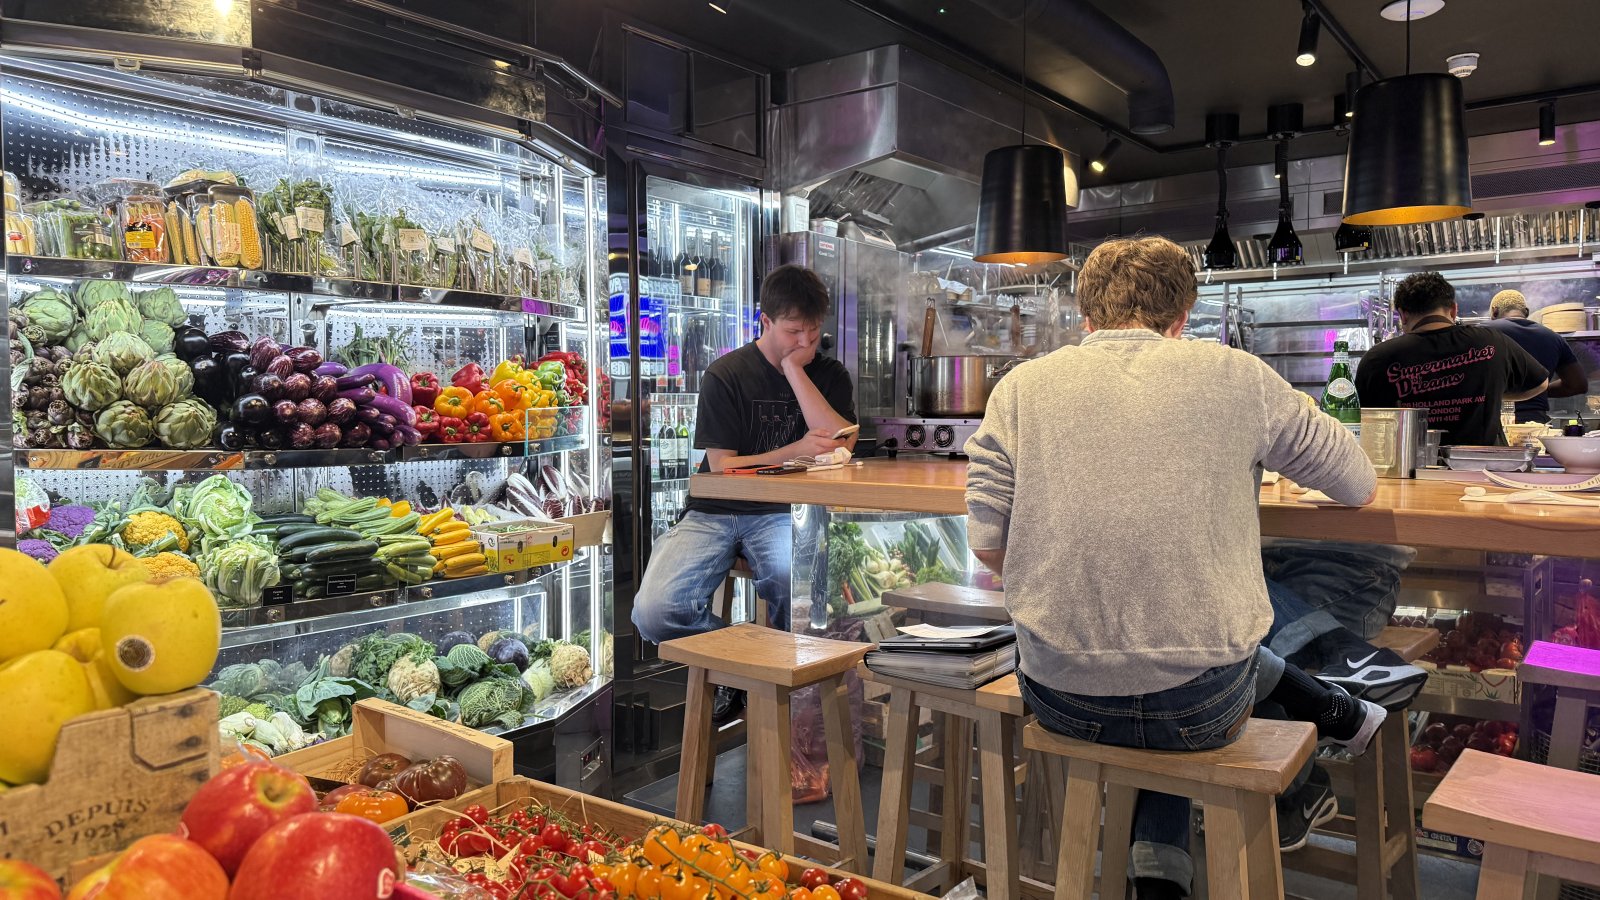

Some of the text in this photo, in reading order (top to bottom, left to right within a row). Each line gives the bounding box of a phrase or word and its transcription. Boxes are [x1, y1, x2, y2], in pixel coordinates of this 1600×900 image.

[1387, 344, 1495, 383] Supermarket
[1395, 372, 1465, 398] Dreams
[1412, 399, 1450, 408] HOLLAND
[1451, 397, 1473, 405] PARK
[44, 798, 152, 839] DEPUIS
